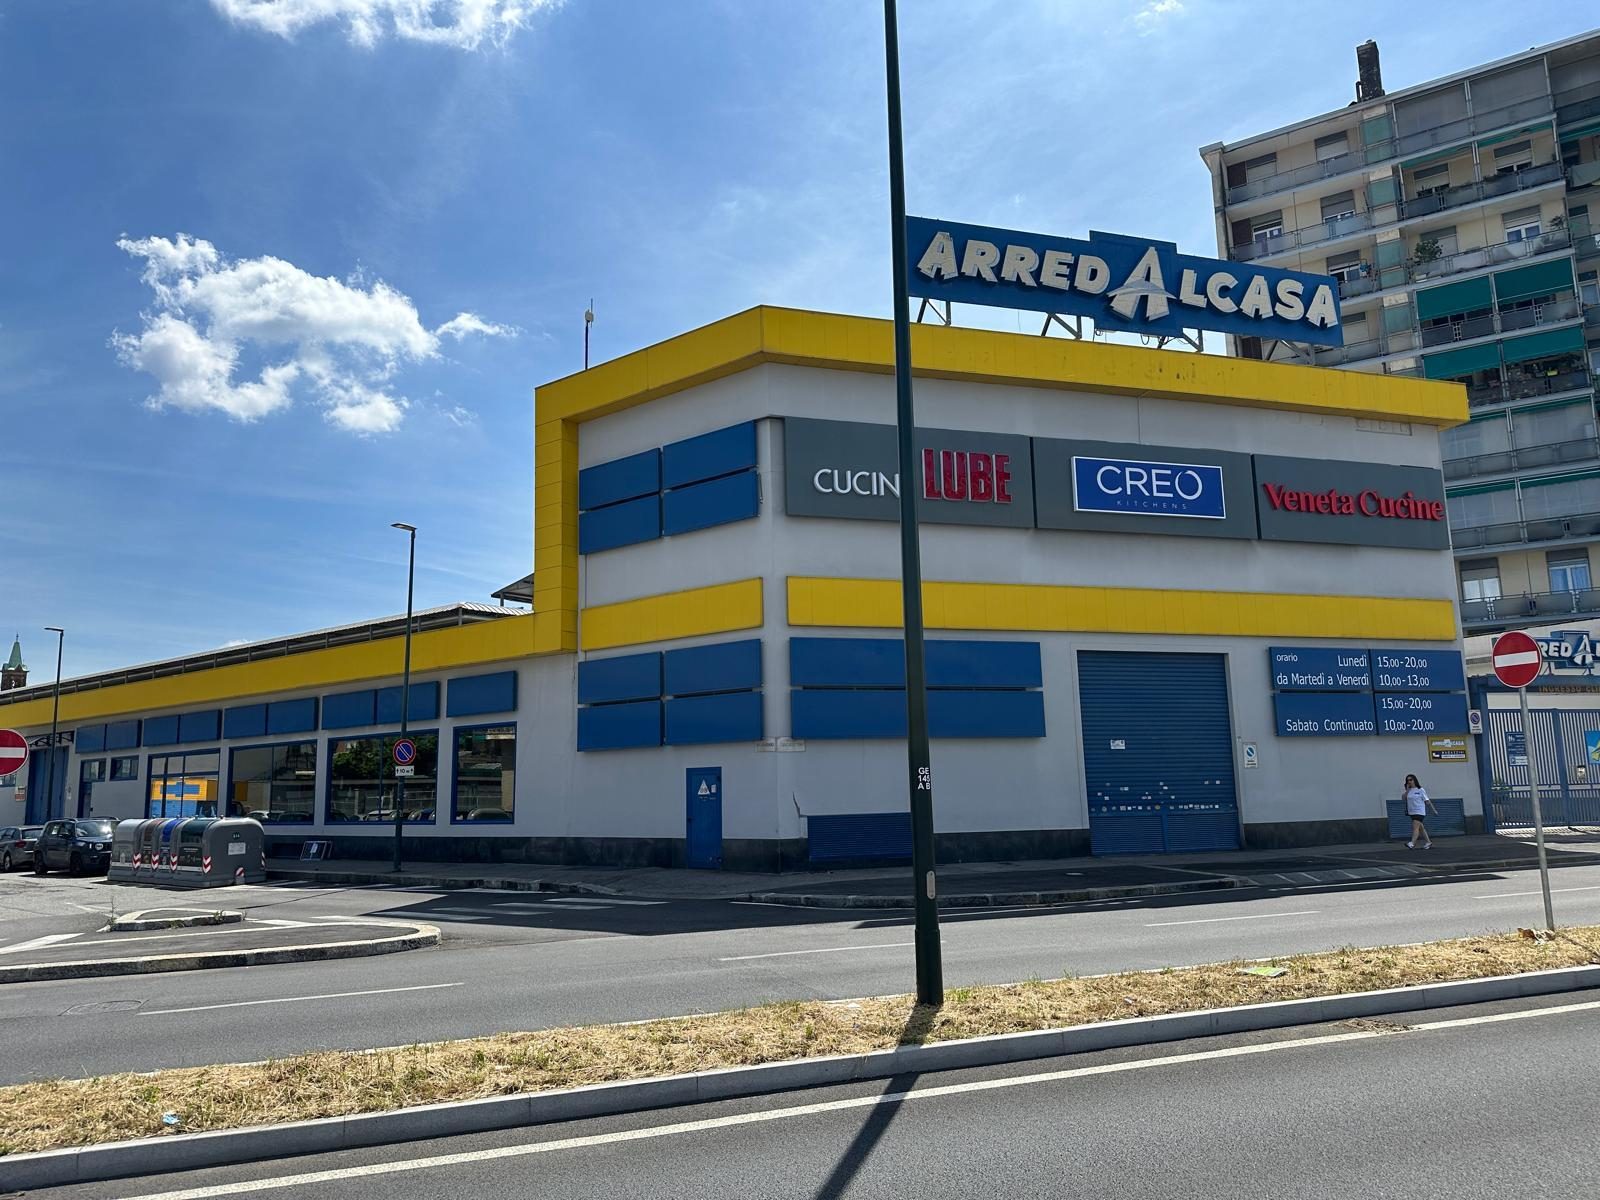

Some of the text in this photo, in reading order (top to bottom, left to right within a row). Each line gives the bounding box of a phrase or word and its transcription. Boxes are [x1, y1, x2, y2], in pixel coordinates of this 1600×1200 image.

[813, 448, 1012, 504] CUCIN LUBE
[1096, 465, 1203, 500] CREO
[1116, 500, 1188, 510] KITCHENS
[1263, 482, 1445, 521] Veneta Cucine
[1276, 654, 1298, 662] orario
[1337, 654, 1368, 667] Lunedì
[1276, 673, 1288, 685] da
[1291, 673, 1325, 685] Martedì
[1327, 676, 1334, 685] a
[1337, 673, 1369, 686] Venerdì
[1286, 719, 1319, 732] Sabato
[1323, 719, 1374, 731] Continuato
[918, 767, 929, 775] GE
